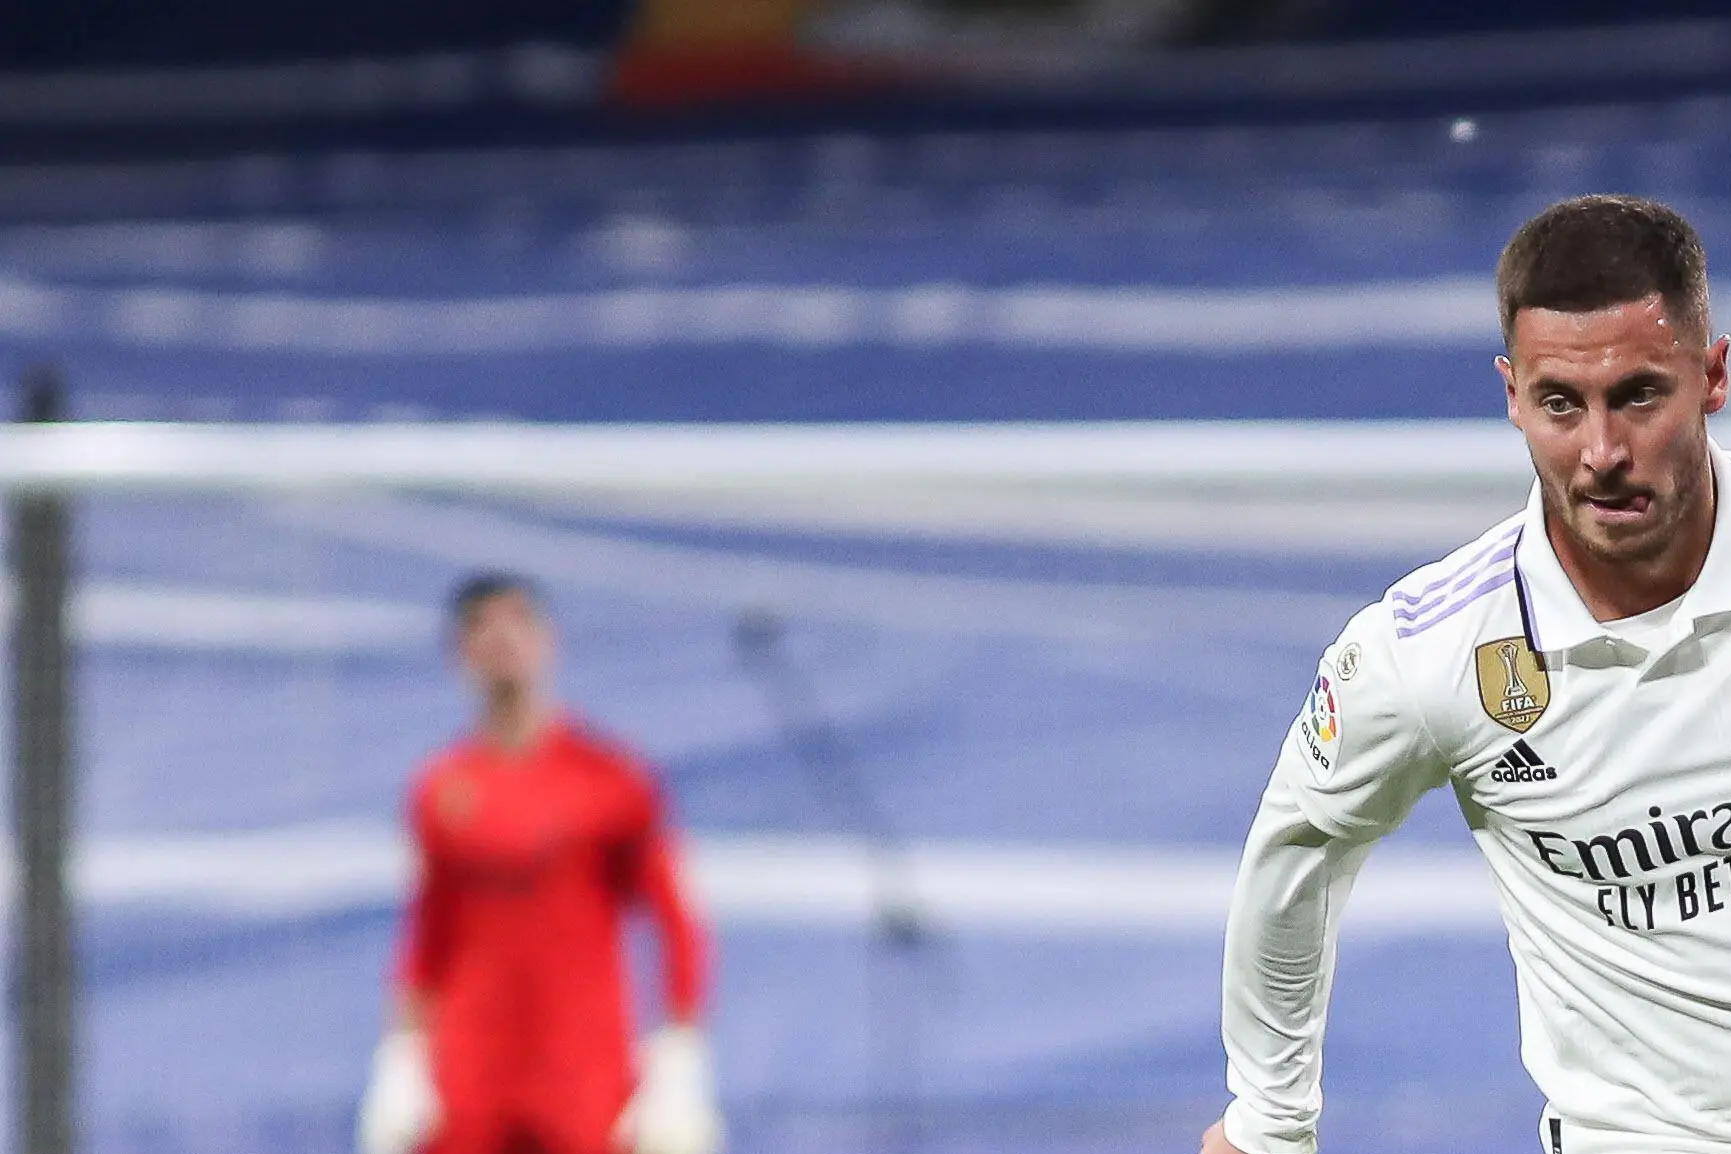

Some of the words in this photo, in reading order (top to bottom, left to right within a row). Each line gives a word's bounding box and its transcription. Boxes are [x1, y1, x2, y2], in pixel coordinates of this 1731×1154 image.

[1501, 696, 1535, 712] FIFA
[1491, 766, 1557, 783] adidas
[1598, 883, 1657, 931] FLY
